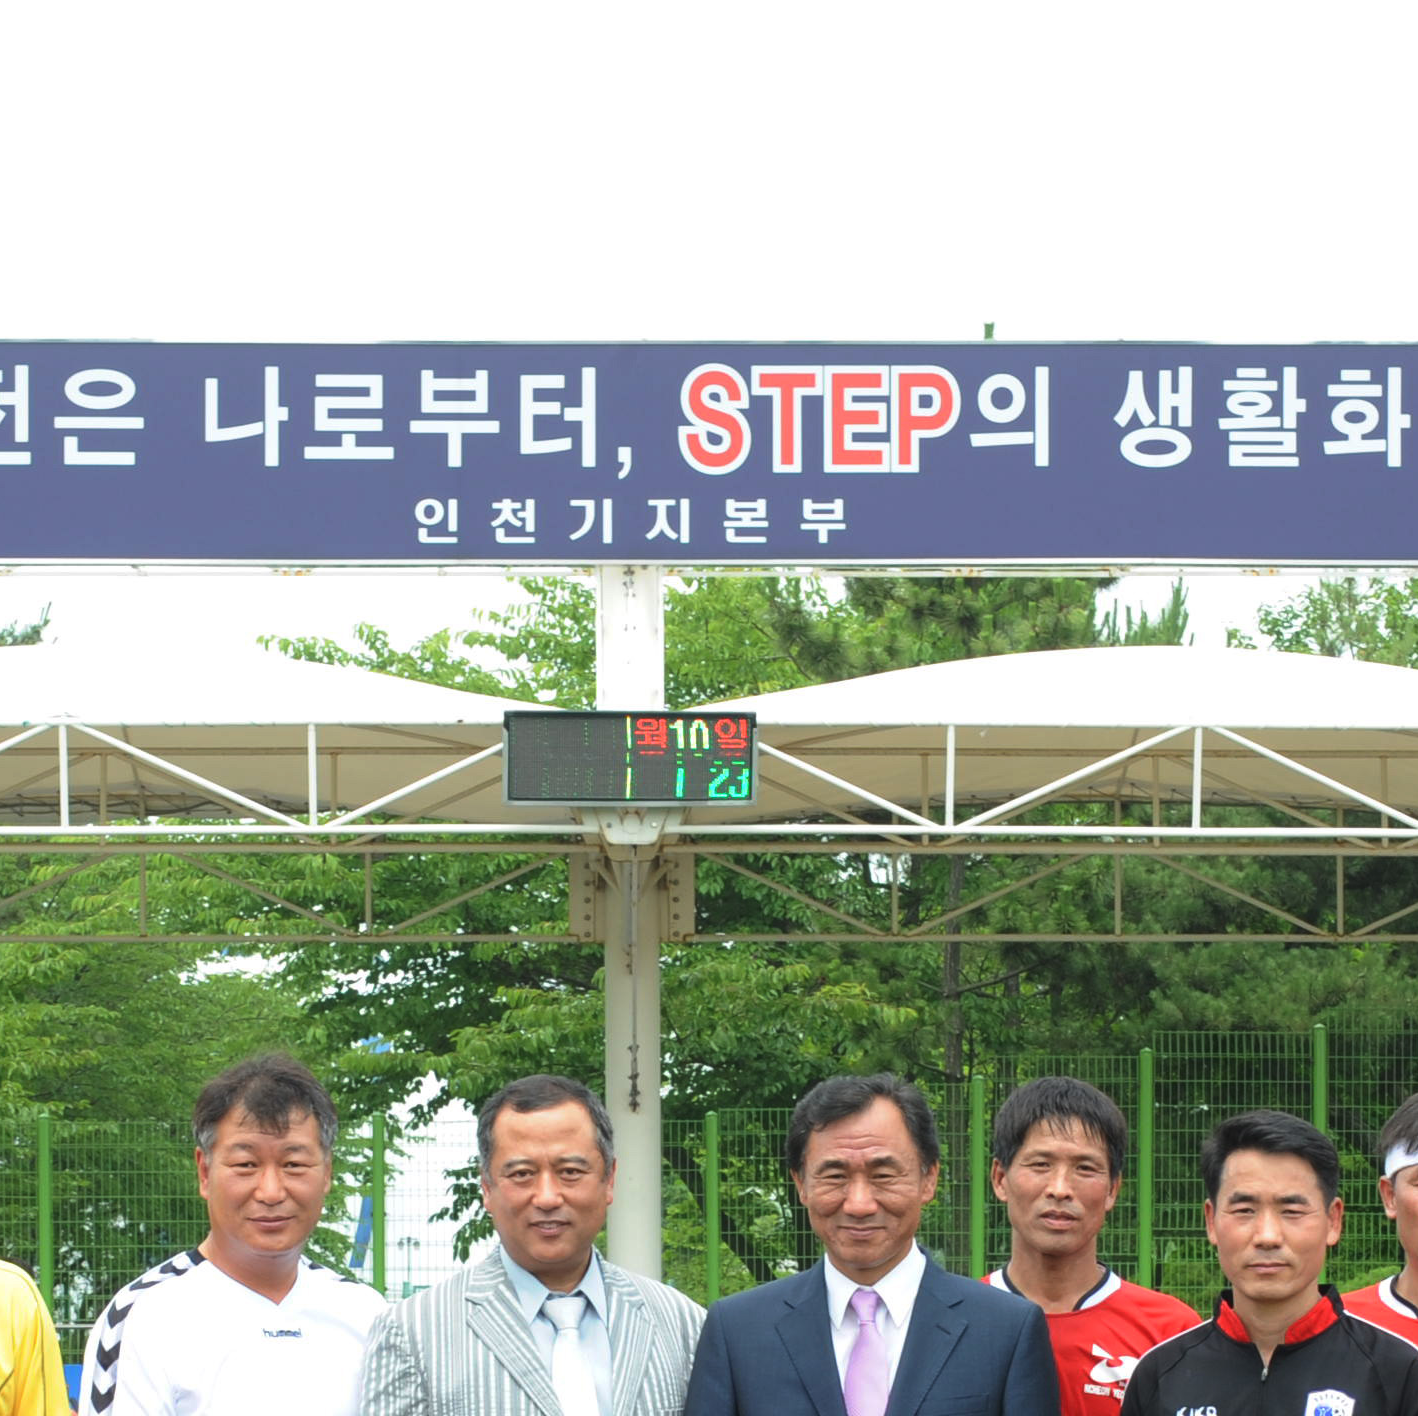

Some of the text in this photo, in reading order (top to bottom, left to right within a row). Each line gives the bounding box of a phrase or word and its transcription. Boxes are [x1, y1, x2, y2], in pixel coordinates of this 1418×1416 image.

[203, 364, 633, 478] 나로부터,
[677, 362, 1051, 477] STEP의
[1114, 365, 1413, 469] 생활화
